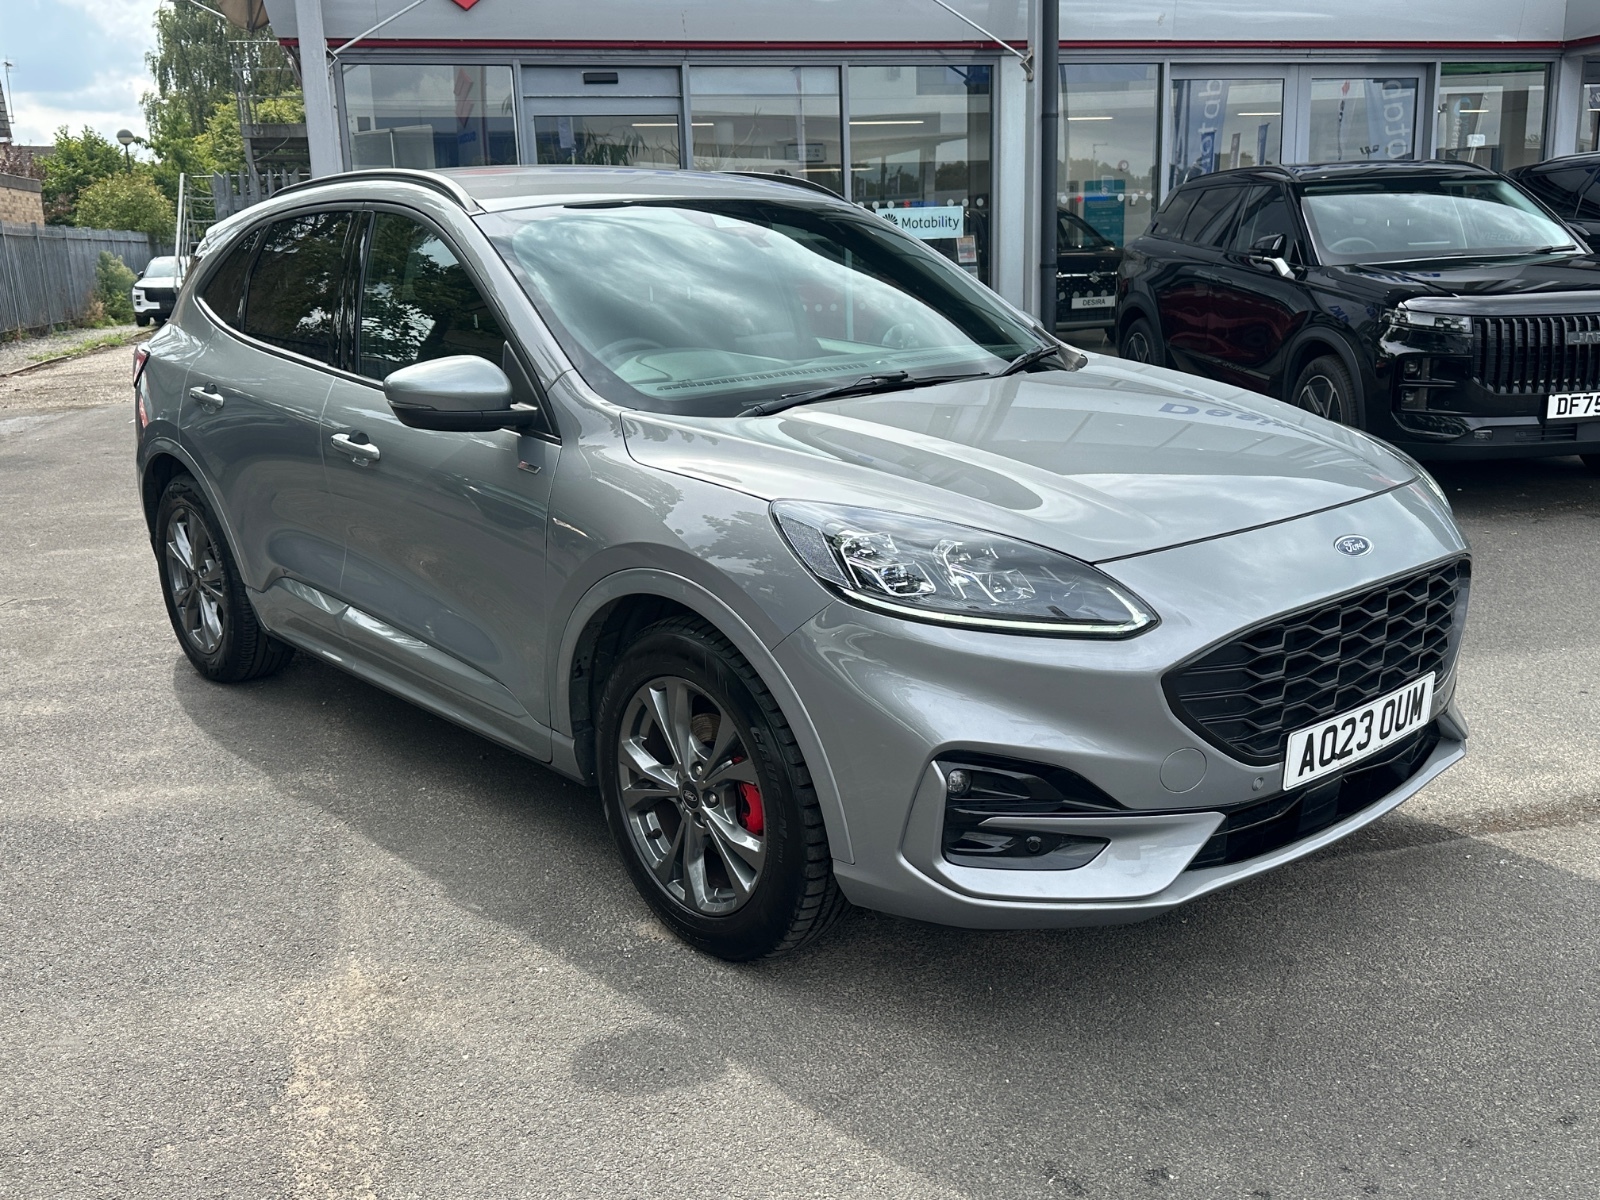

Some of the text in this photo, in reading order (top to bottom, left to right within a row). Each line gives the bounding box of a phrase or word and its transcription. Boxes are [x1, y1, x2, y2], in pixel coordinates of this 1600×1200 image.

[901, 216, 960, 231] Motability
[1082, 298, 1106, 306] DESIRA
[1556, 395, 1600, 415] DF75
[1379, 682, 1426, 740] OUM
